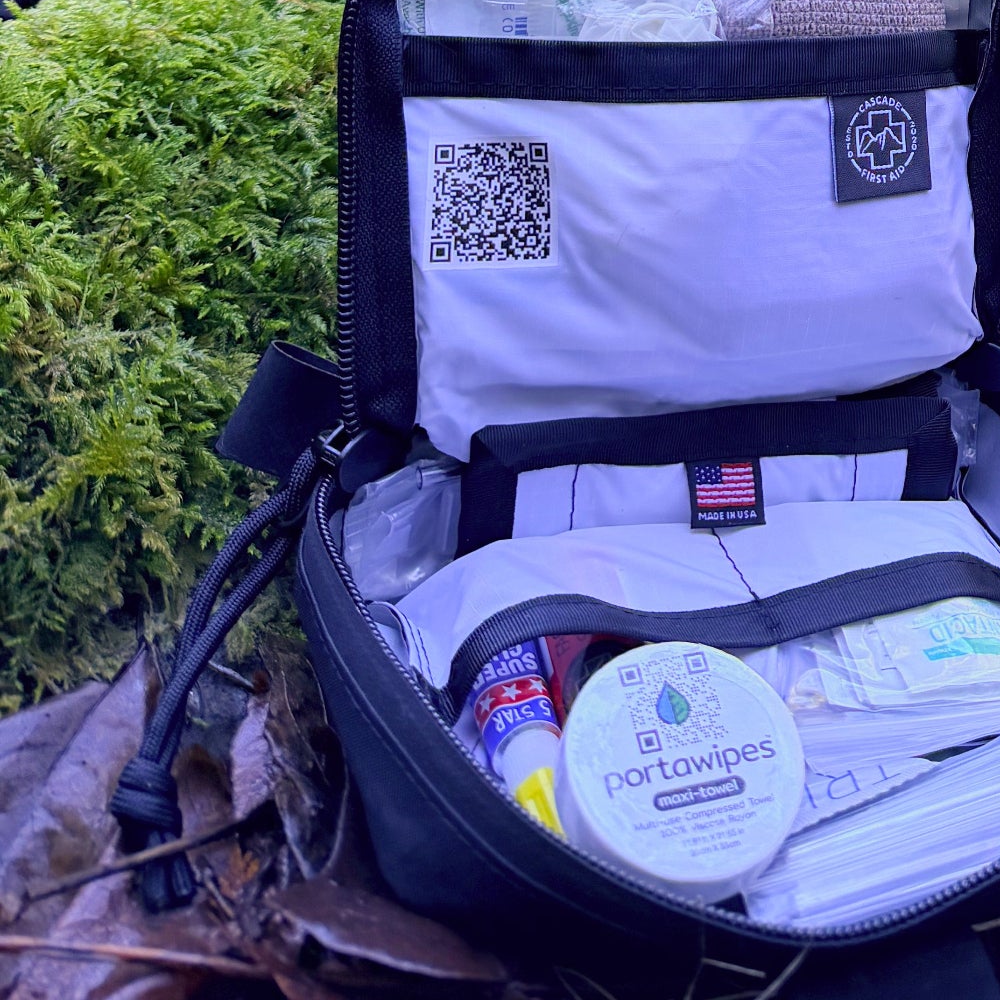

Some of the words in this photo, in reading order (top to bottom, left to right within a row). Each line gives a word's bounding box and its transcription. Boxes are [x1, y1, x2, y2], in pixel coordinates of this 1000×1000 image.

[859, 95, 903, 113] CASCADE
[909, 121, 917, 151] 2020
[861, 168, 887, 184] FIRST
[889, 165, 906, 181] AID
[698, 511, 725, 520] MADE
[726, 511, 736, 519] IN
[737, 510, 757, 519] USA
[491, 704, 535, 733] STAR
[538, 700, 552, 717] 5
[603, 739, 777, 800] portawipes
[660, 778, 739, 808] maxi-towel
[685, 801, 746, 822] Compressed
